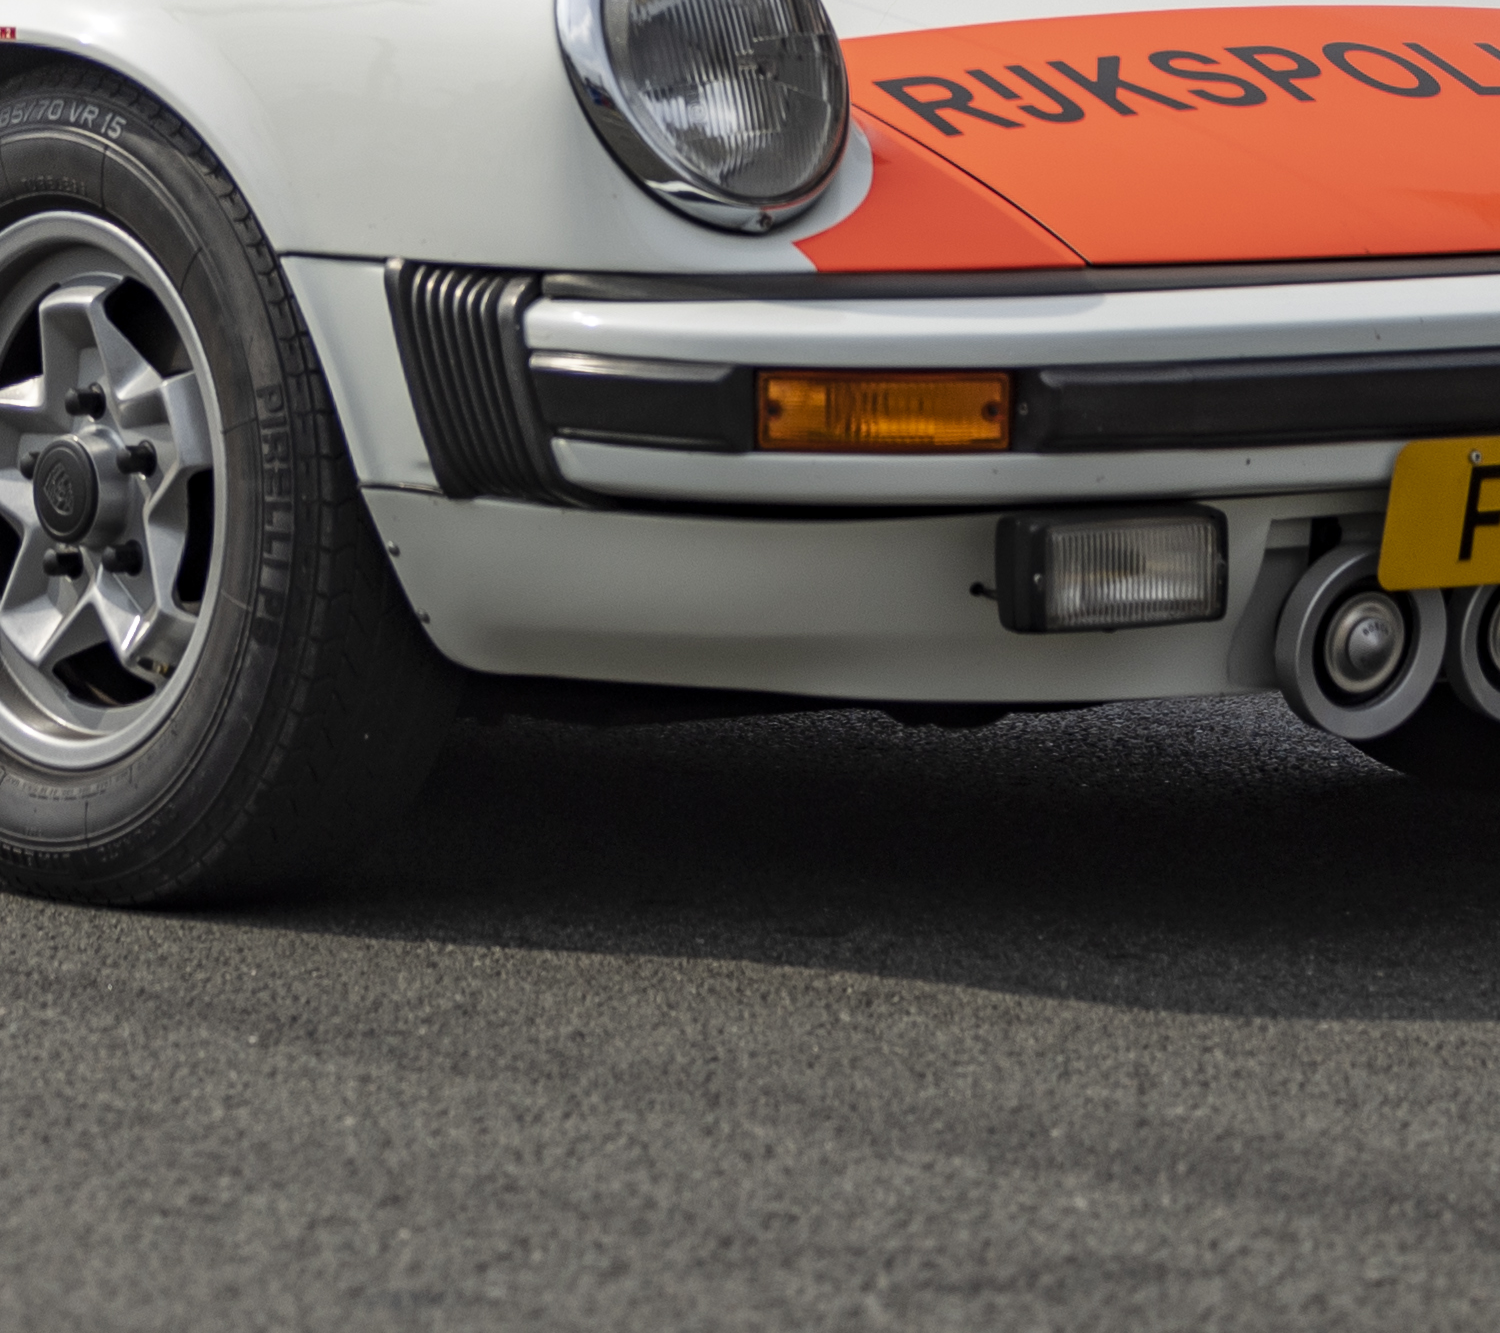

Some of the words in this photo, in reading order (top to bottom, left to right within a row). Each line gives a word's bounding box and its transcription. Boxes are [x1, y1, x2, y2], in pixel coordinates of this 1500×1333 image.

[68, 99, 101, 130] VR
[100, 110, 129, 141] 15
[255, 383, 294, 571] PIRELLI
